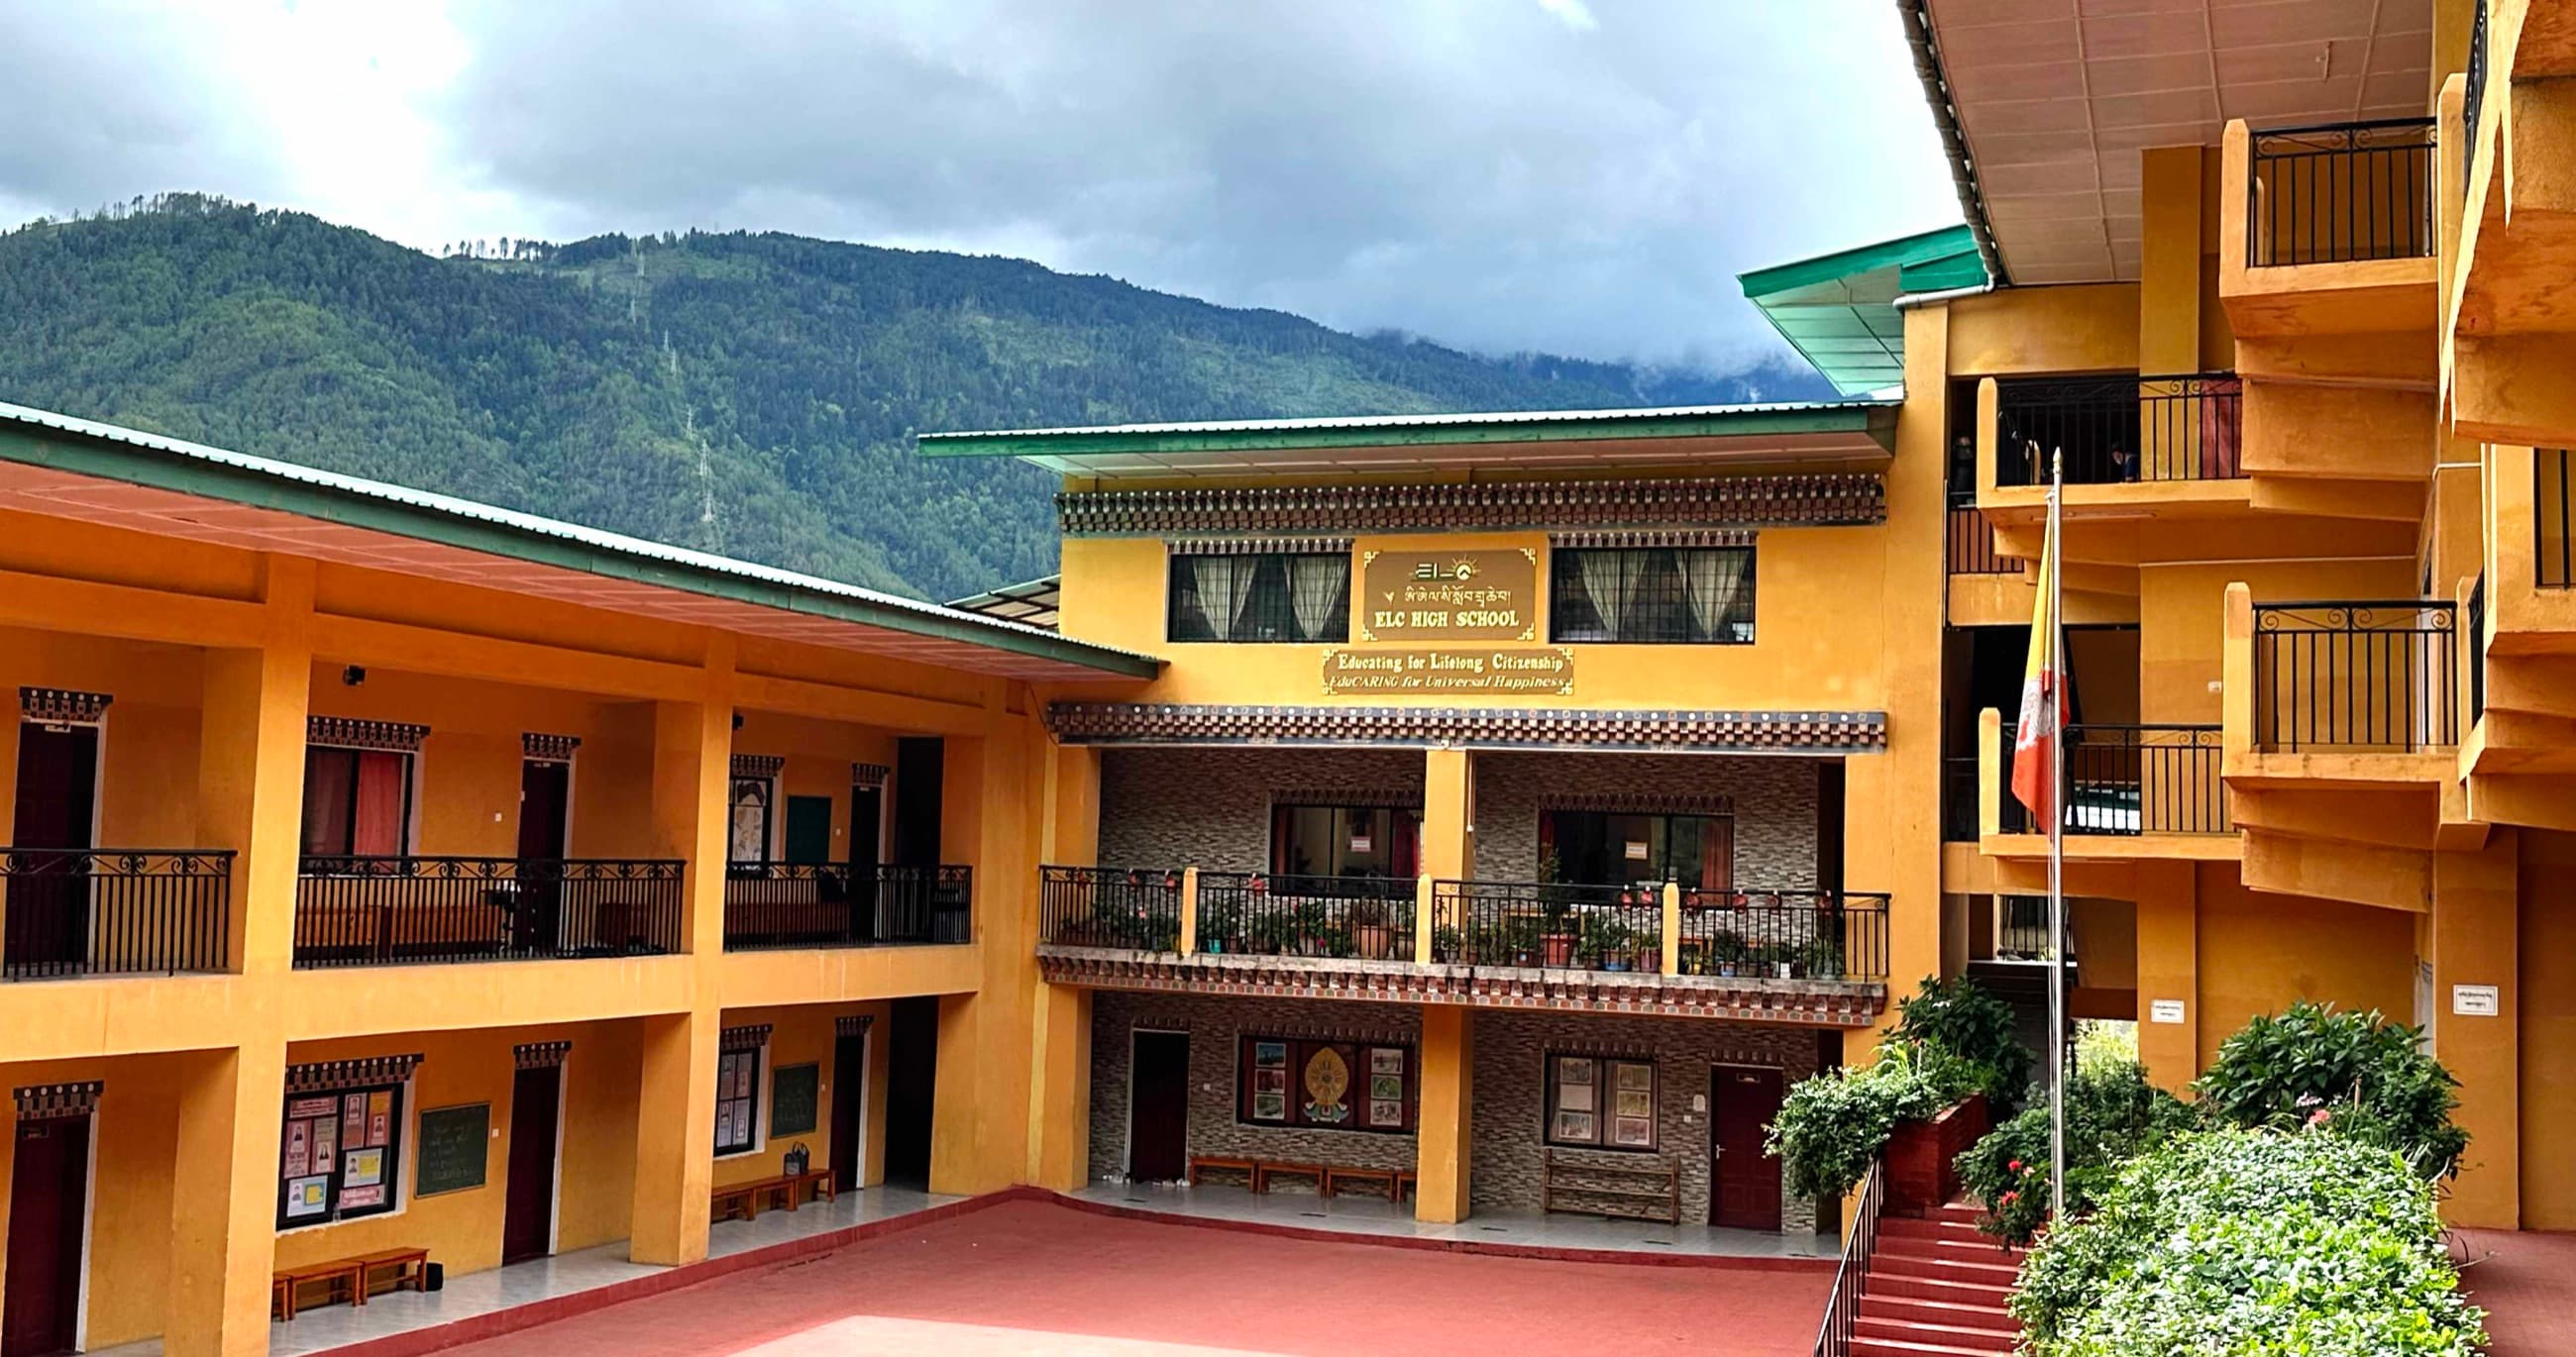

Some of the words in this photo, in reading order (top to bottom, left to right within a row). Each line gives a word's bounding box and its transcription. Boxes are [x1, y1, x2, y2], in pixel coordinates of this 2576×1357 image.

[1374, 610, 1406, 628] ELC
[1411, 610, 1449, 628] HIGH
[1455, 609, 1520, 627] SCHOOL
[1338, 653, 1403, 674] Educating
[1407, 654, 1426, 670] for
[1430, 653, 1484, 674] Lifelong
[1492, 653, 1563, 674] Citizenship
[1329, 676, 1399, 687] EduCARING
[1401, 676, 1423, 687] for
[1426, 676, 1492, 687] Universal
[1493, 676, 1564, 690] Happiness
